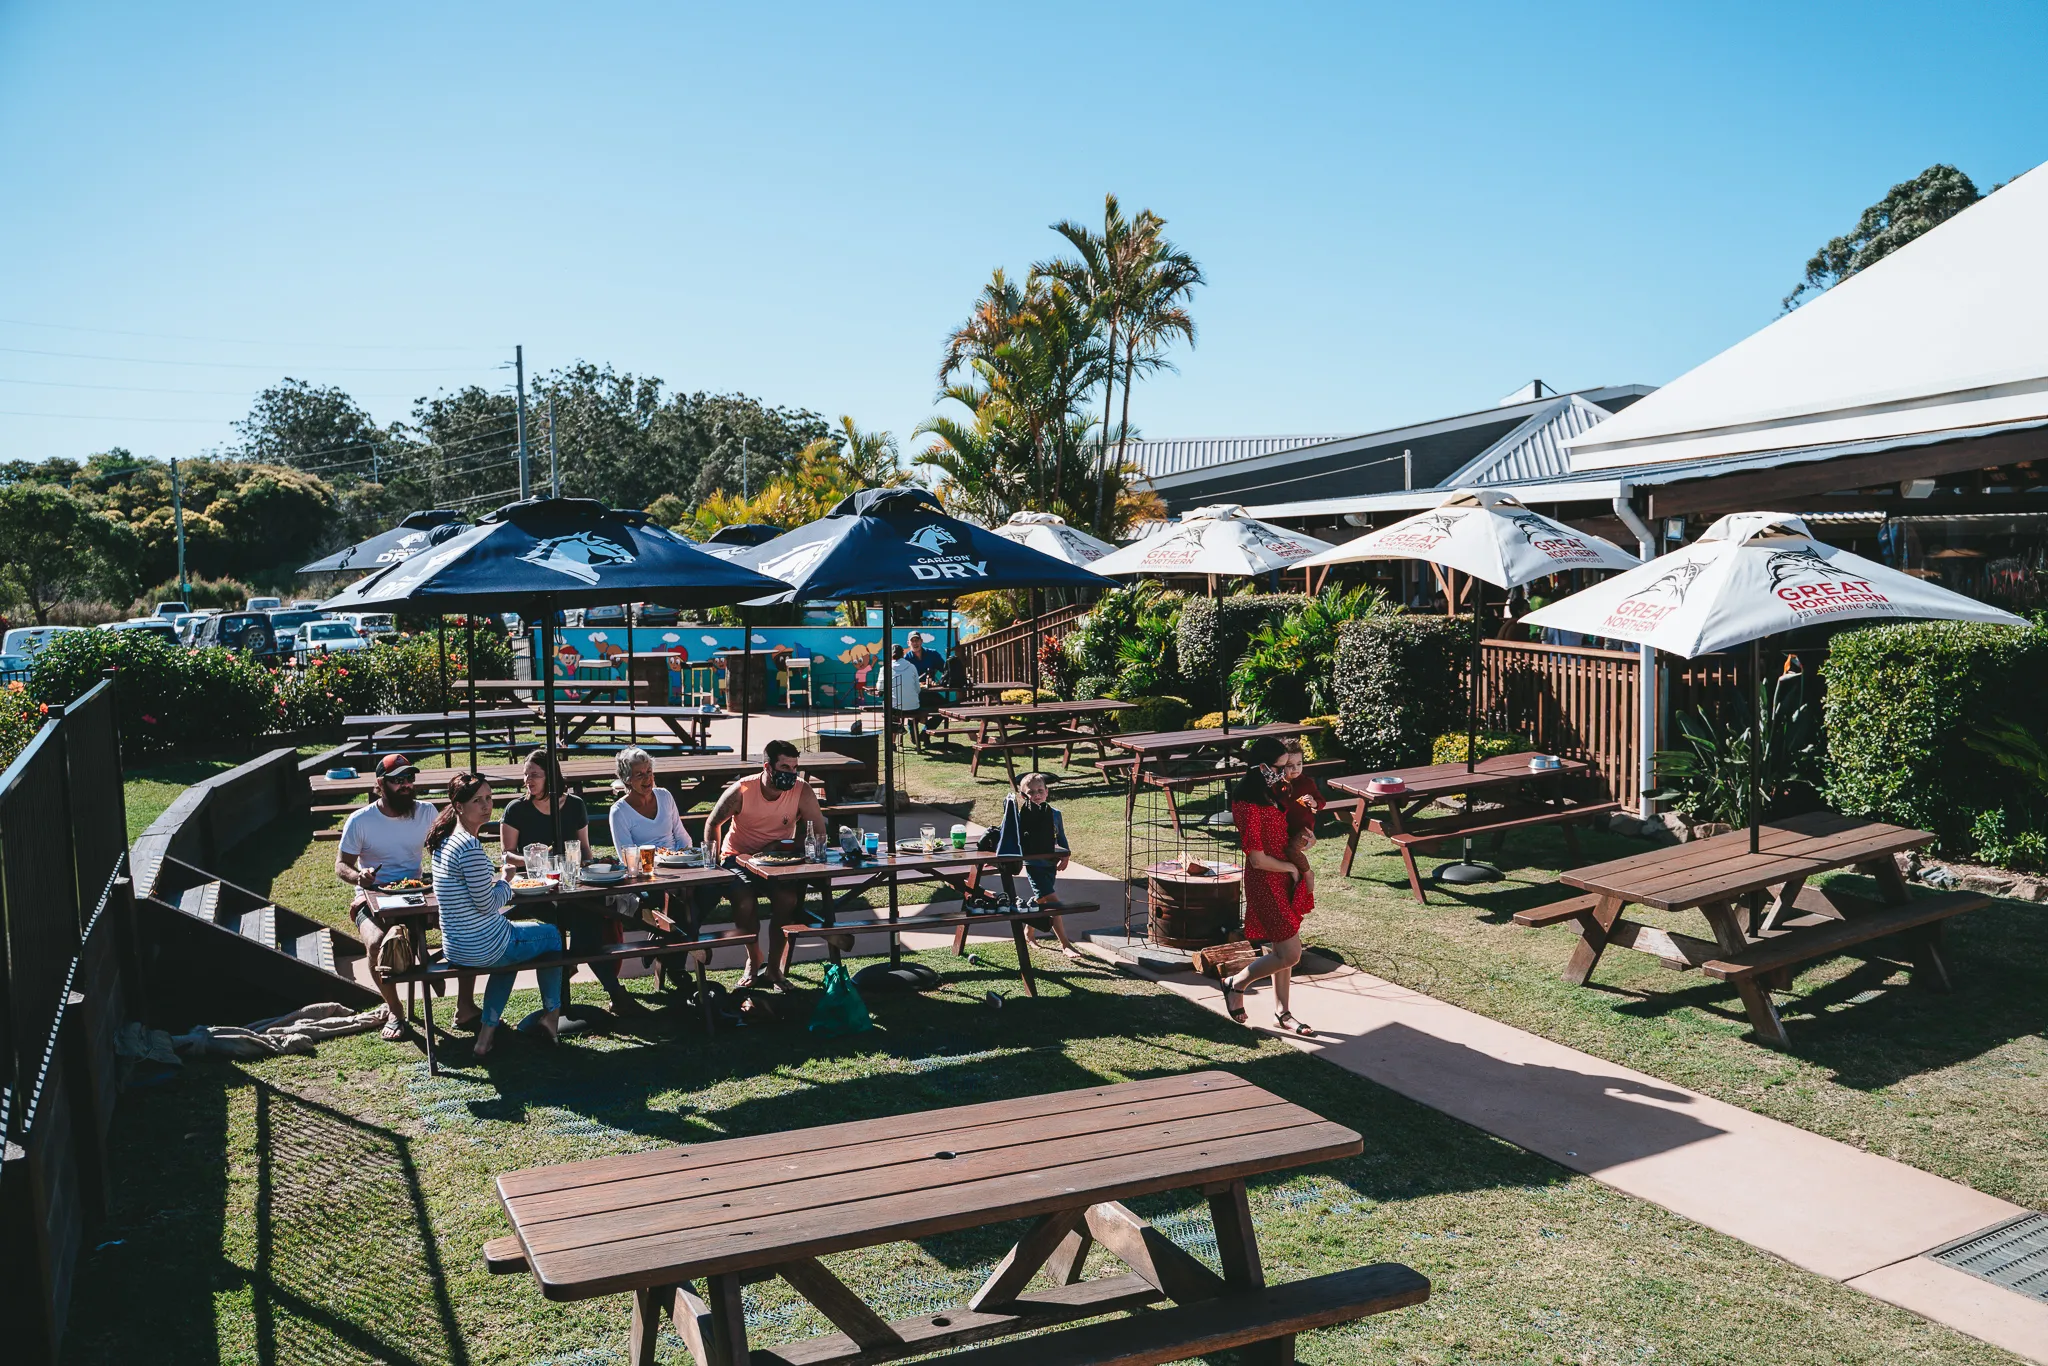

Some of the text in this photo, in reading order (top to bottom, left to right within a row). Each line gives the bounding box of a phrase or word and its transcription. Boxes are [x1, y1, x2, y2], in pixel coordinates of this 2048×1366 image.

[1534, 539, 1588, 551] GREAT
[917, 554, 971, 564] CARLTON
[1146, 549, 1202, 559] GREAT
[1545, 549, 1600, 559] NORTHERN
[908, 561, 989, 580] DRY
[1776, 581, 1874, 601] GREAT
[1787, 594, 1890, 612] NORTHERN
[1815, 603, 1864, 615] BREWING
[1615, 600, 1678, 621] GREAT
[1602, 615, 1657, 632] NORTHERN
